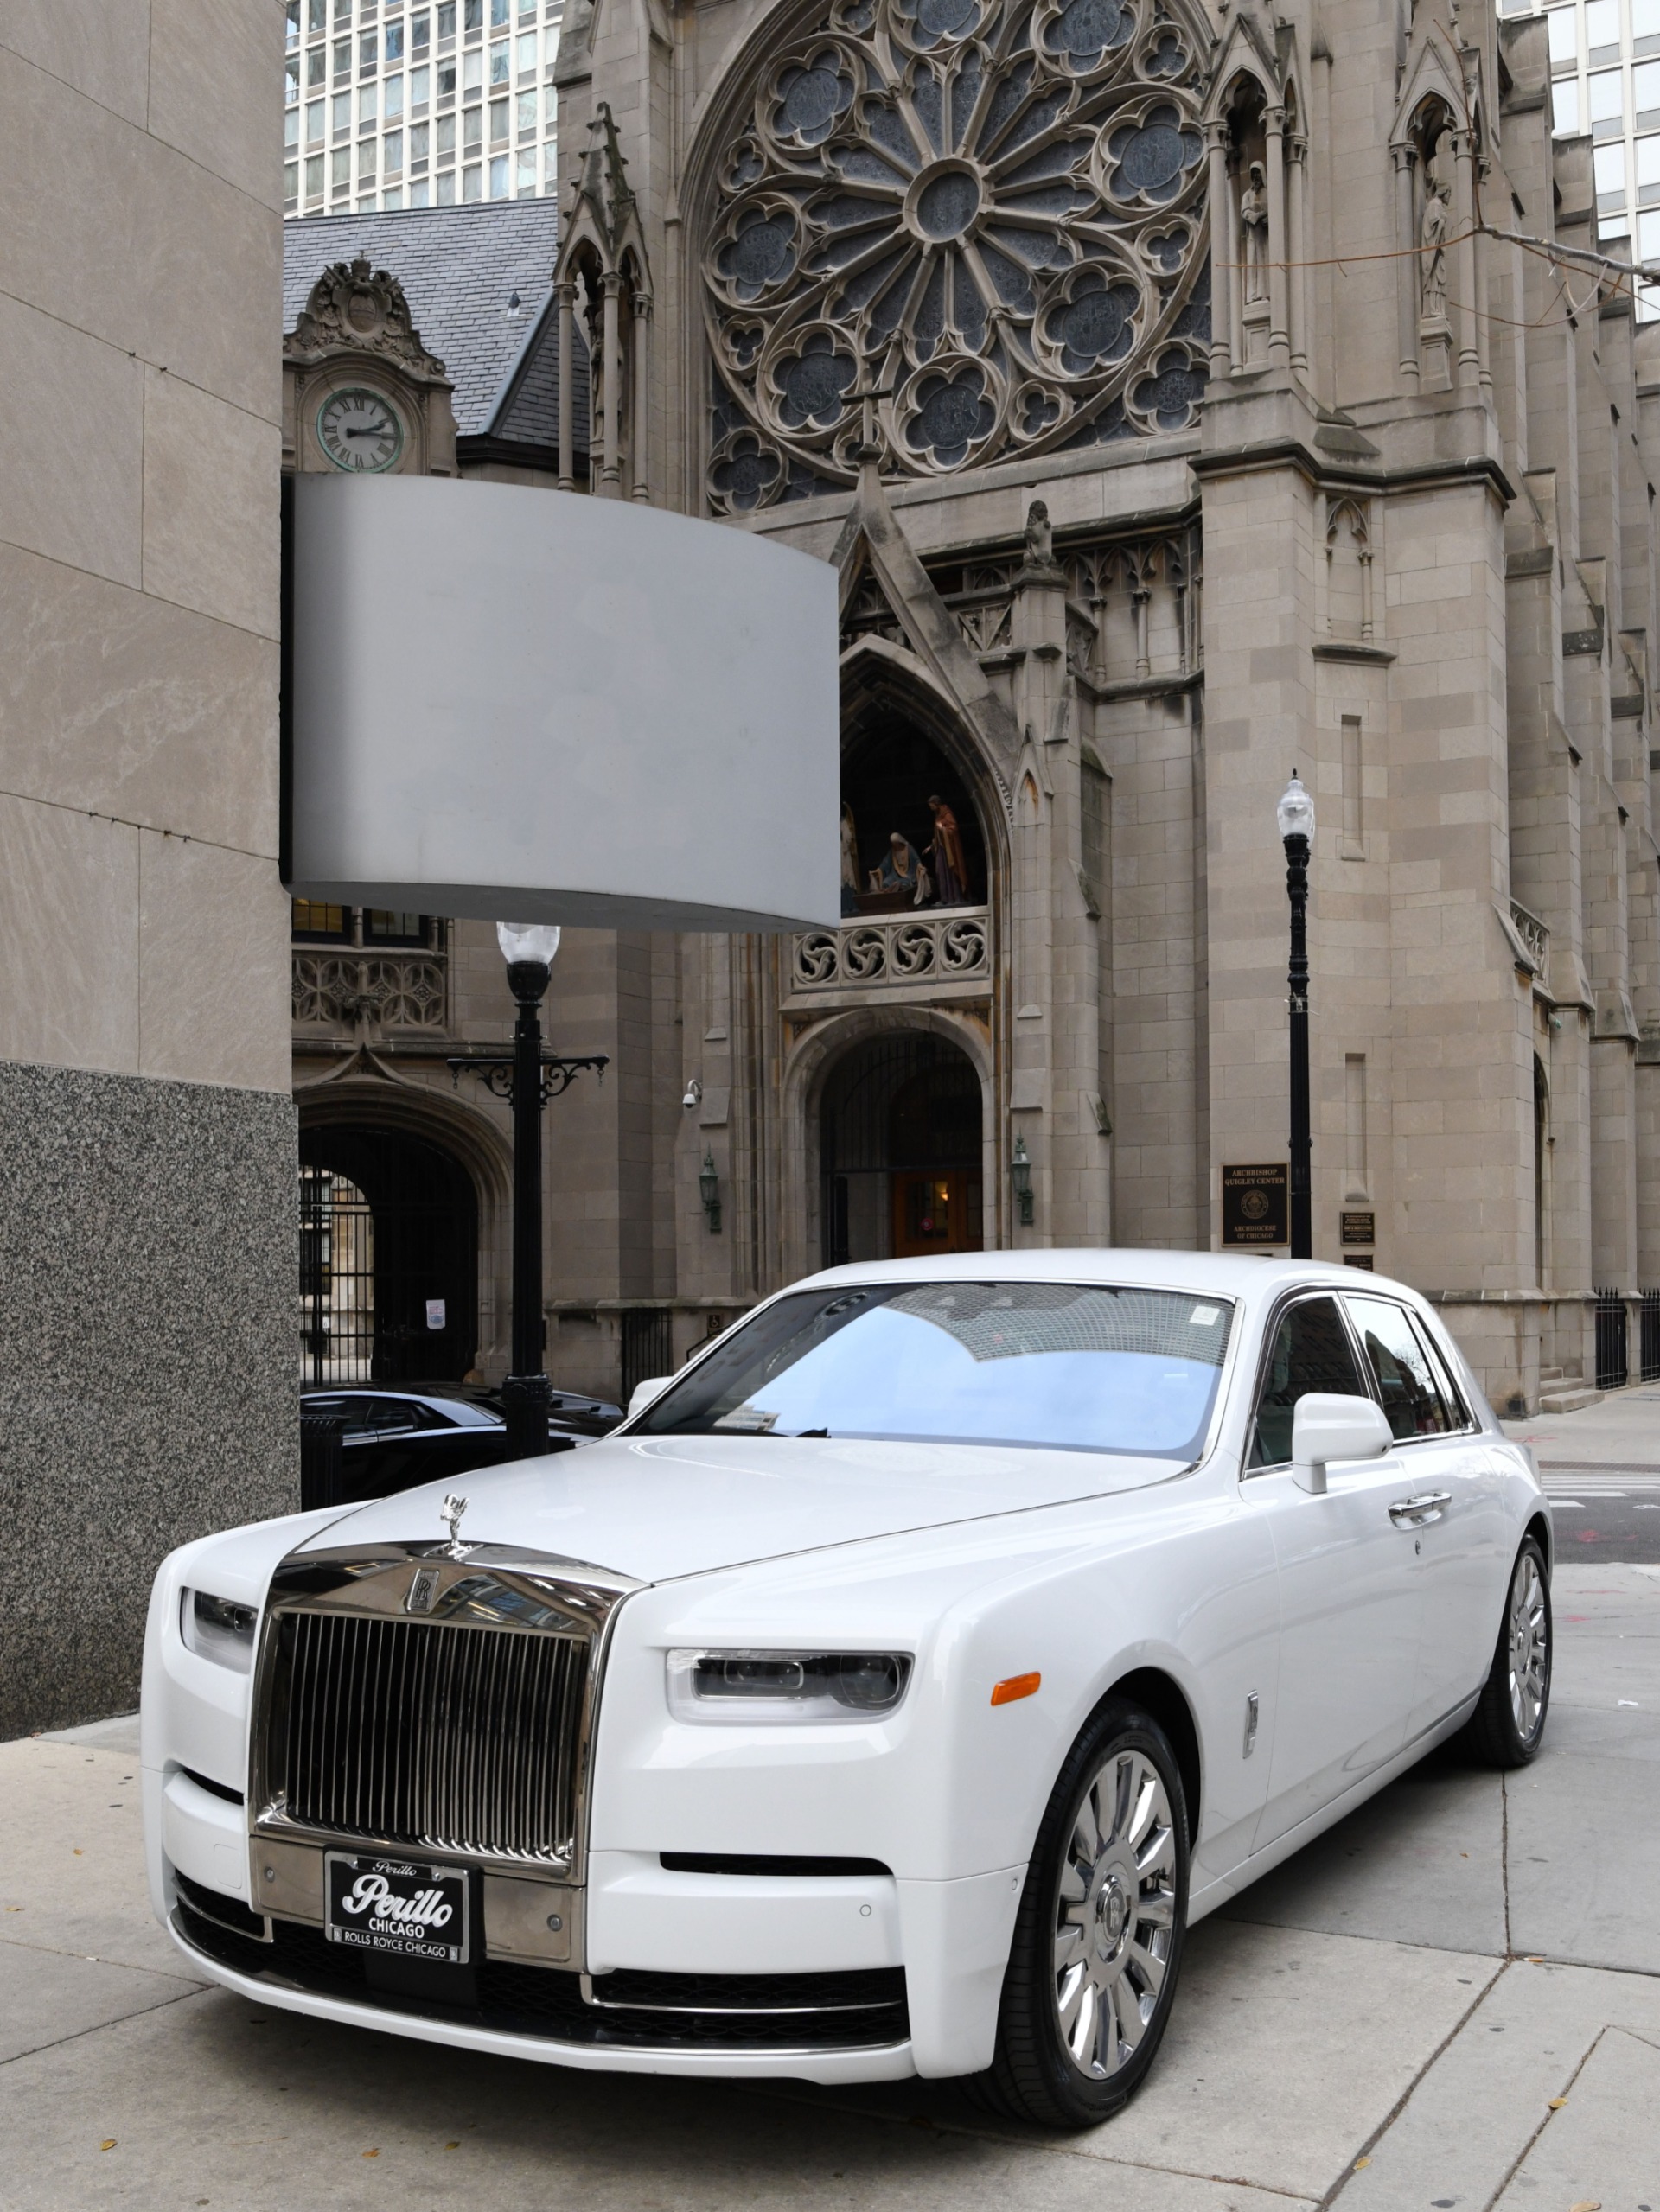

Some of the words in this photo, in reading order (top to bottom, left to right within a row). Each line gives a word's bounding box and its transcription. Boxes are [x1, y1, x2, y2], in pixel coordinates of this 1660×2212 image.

[1224, 1178, 1256, 1187] QUIGLEY
[372, 1860, 417, 1877] Perillo
[342, 1874, 453, 1928] Perillo
[368, 1917, 425, 1939] CHICAGO
[344, 1931, 371, 1946] ROLLS
[373, 1937, 403, 1951] ROYCE
[405, 1941, 446, 1958] CHICAGO
